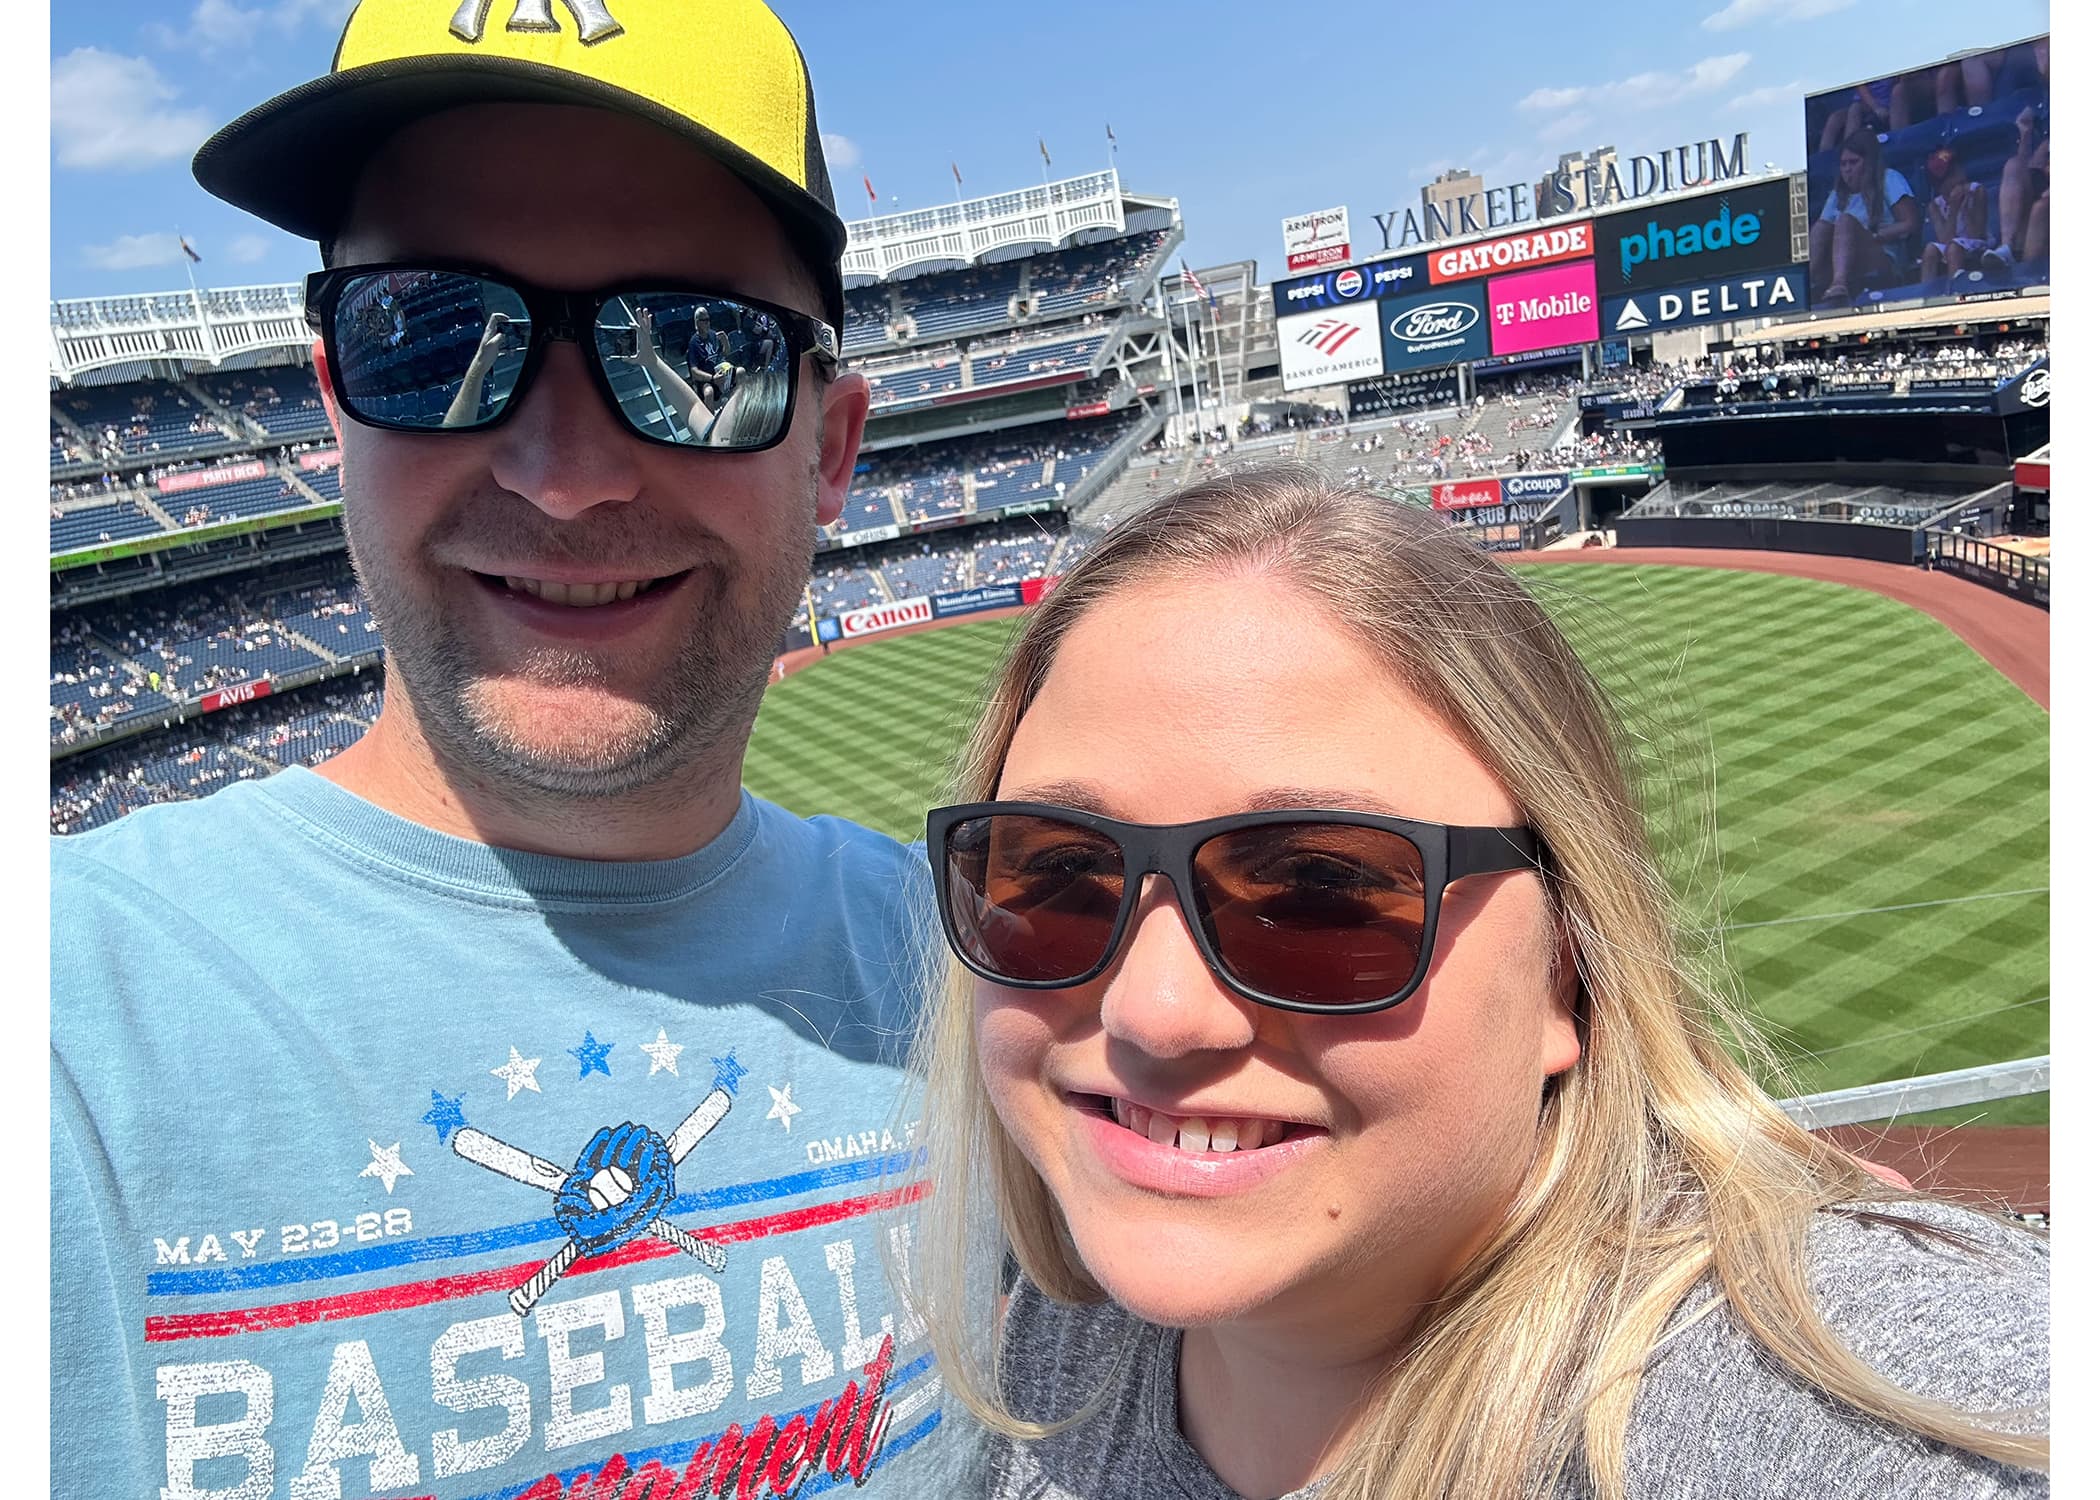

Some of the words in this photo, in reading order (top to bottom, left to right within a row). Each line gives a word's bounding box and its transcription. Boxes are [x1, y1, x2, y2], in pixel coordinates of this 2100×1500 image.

[1371, 182, 1530, 250] YANKEE
[1551, 132, 1751, 214] STADIUM
[1286, 213, 1343, 232] ARMITRON
[1438, 226, 1586, 276] GATORADE
[1619, 197, 1761, 284] phade
[1292, 246, 1344, 264] ARMITRON
[1339, 279, 1360, 288] PEPSI
[1375, 267, 1413, 283] PEPSI
[1287, 284, 1325, 300] PEPSI
[1659, 276, 1795, 321] DELTA
[1405, 307, 1462, 337] Ford
[1286, 368, 1313, 381] BANK
[1317, 365, 1329, 375] OF
[1331, 357, 1379, 372] AMERICA
[202, 468, 233, 484] PARTY
[234, 463, 260, 479] DECK
[1524, 477, 1562, 493] coupa
[1477, 506, 1506, 525] SUB
[844, 602, 929, 633] Canon
[219, 684, 256, 707] AVIS
[153, 1228, 265, 1265] MAY
[281, 1207, 413, 1253] 23-28
